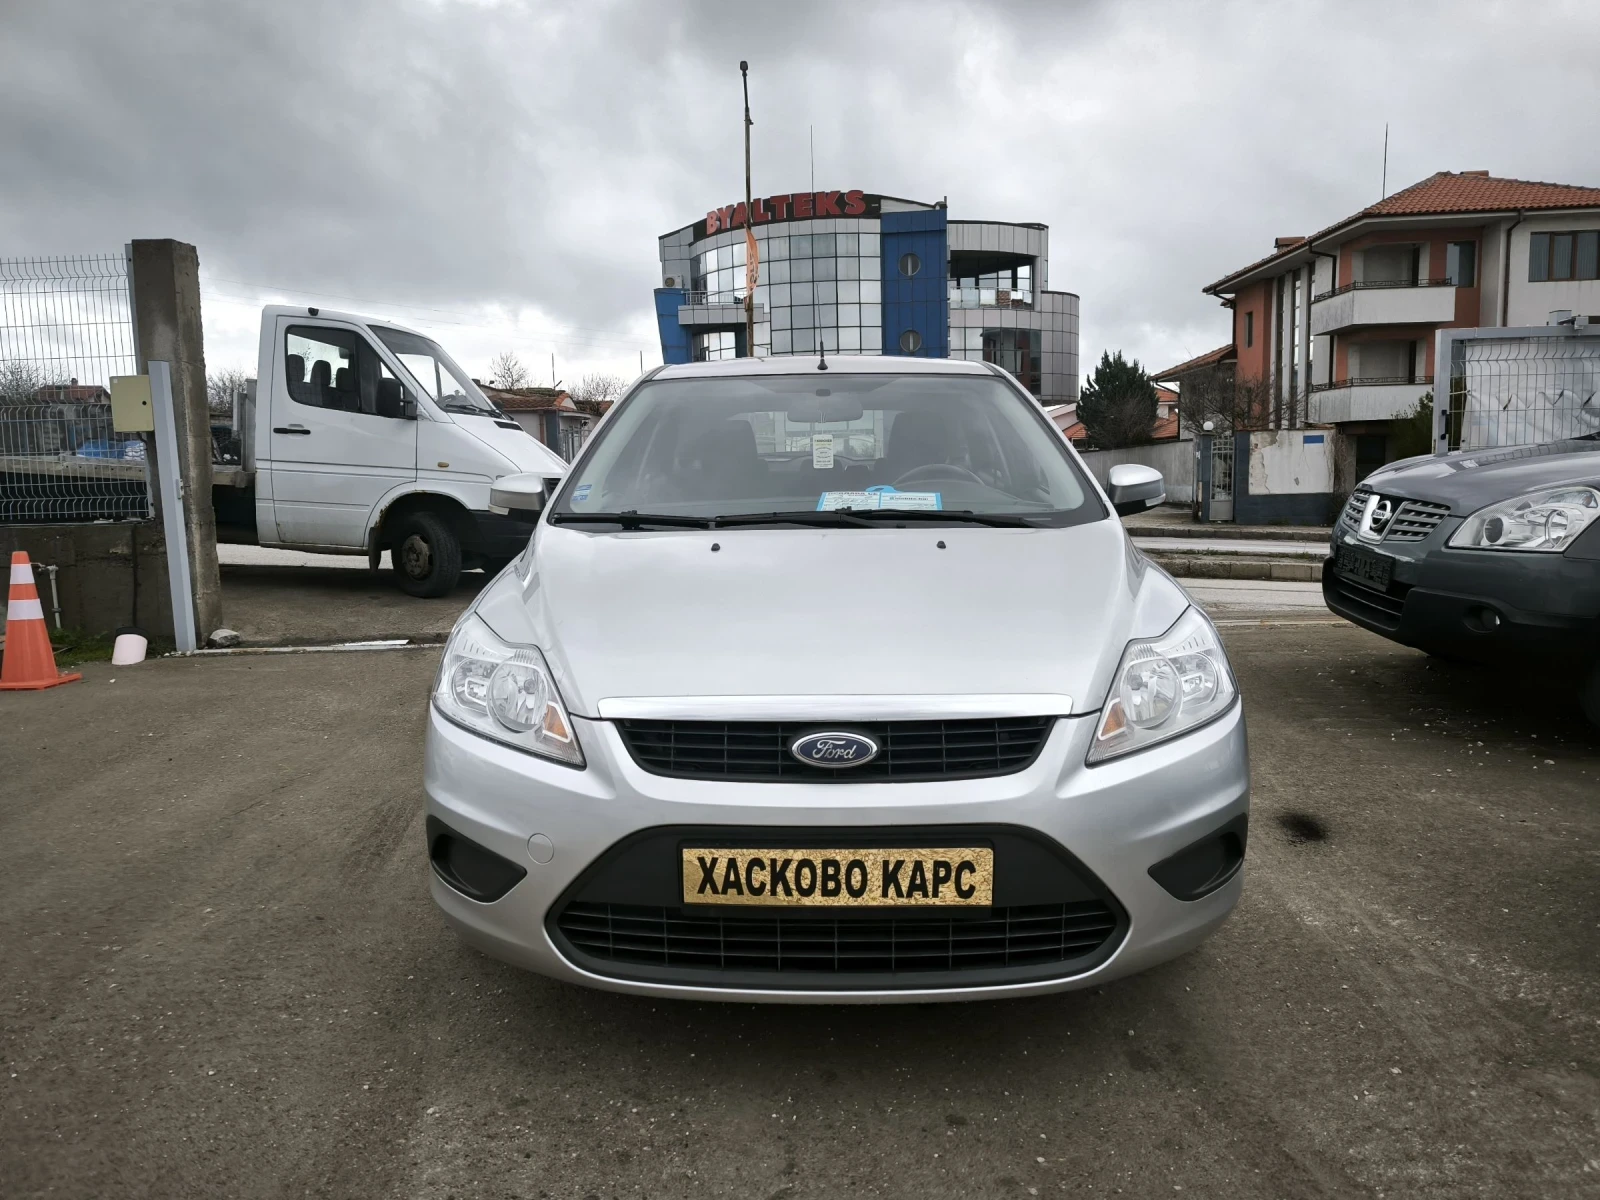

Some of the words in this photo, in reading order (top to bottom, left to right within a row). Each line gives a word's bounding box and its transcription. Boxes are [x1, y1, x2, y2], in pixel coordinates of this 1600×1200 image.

[706, 190, 866, 235] BYALTEKS
[812, 739, 857, 759] Ford
[697, 856, 868, 898] ХАСКОВО
[882, 859, 977, 899] КАРС
